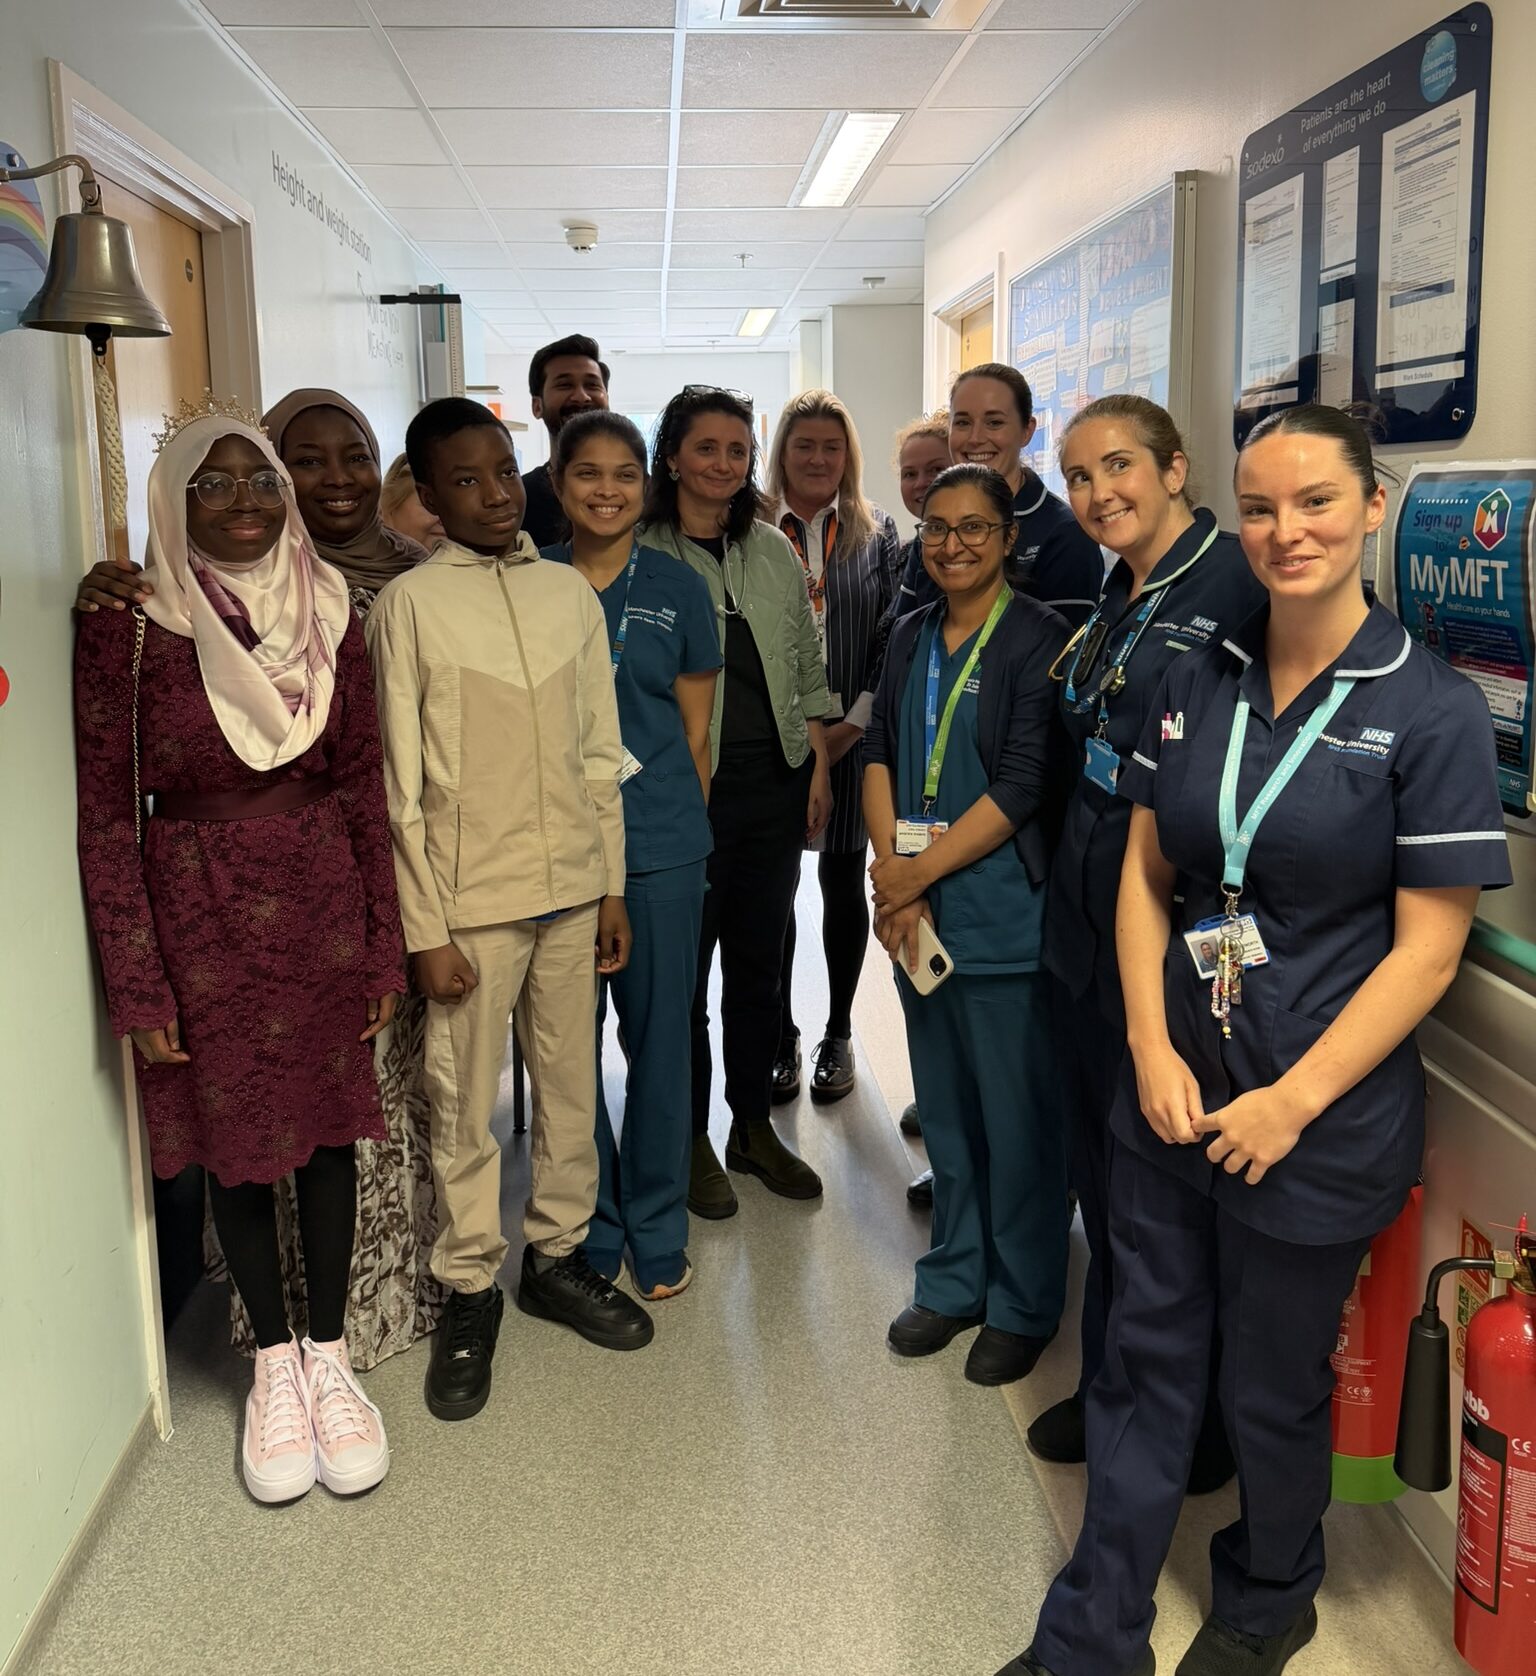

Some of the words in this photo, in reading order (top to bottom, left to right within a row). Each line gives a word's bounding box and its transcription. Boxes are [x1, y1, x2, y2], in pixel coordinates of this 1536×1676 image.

[1424, 64, 1455, 87] matters
[1300, 105, 1332, 133] Patients
[1333, 98, 1348, 115] are
[1349, 86, 1365, 107] the
[1366, 71, 1391, 101] heart
[1302, 137, 1313, 154] of
[1312, 116, 1356, 151] everything
[1357, 107, 1372, 126] we
[1373, 100, 1387, 117] do
[1245, 147, 1286, 180] sodexo
[271, 150, 306, 208] Height
[307, 190, 325, 223] and
[325, 207, 350, 248] weight
[350, 227, 373, 265] station
[1413, 510, 1441, 532] Sign
[1445, 515, 1463, 533] up
[1410, 553, 1509, 604] MyMFT
[1190, 616, 1218, 632] NHS
[1480, 607, 1493, 616] your
[1493, 607, 1511, 618] hands
[1319, 733, 1347, 747] hester
[1347, 741, 1390, 755] University
[1361, 729, 1395, 744] NHS
